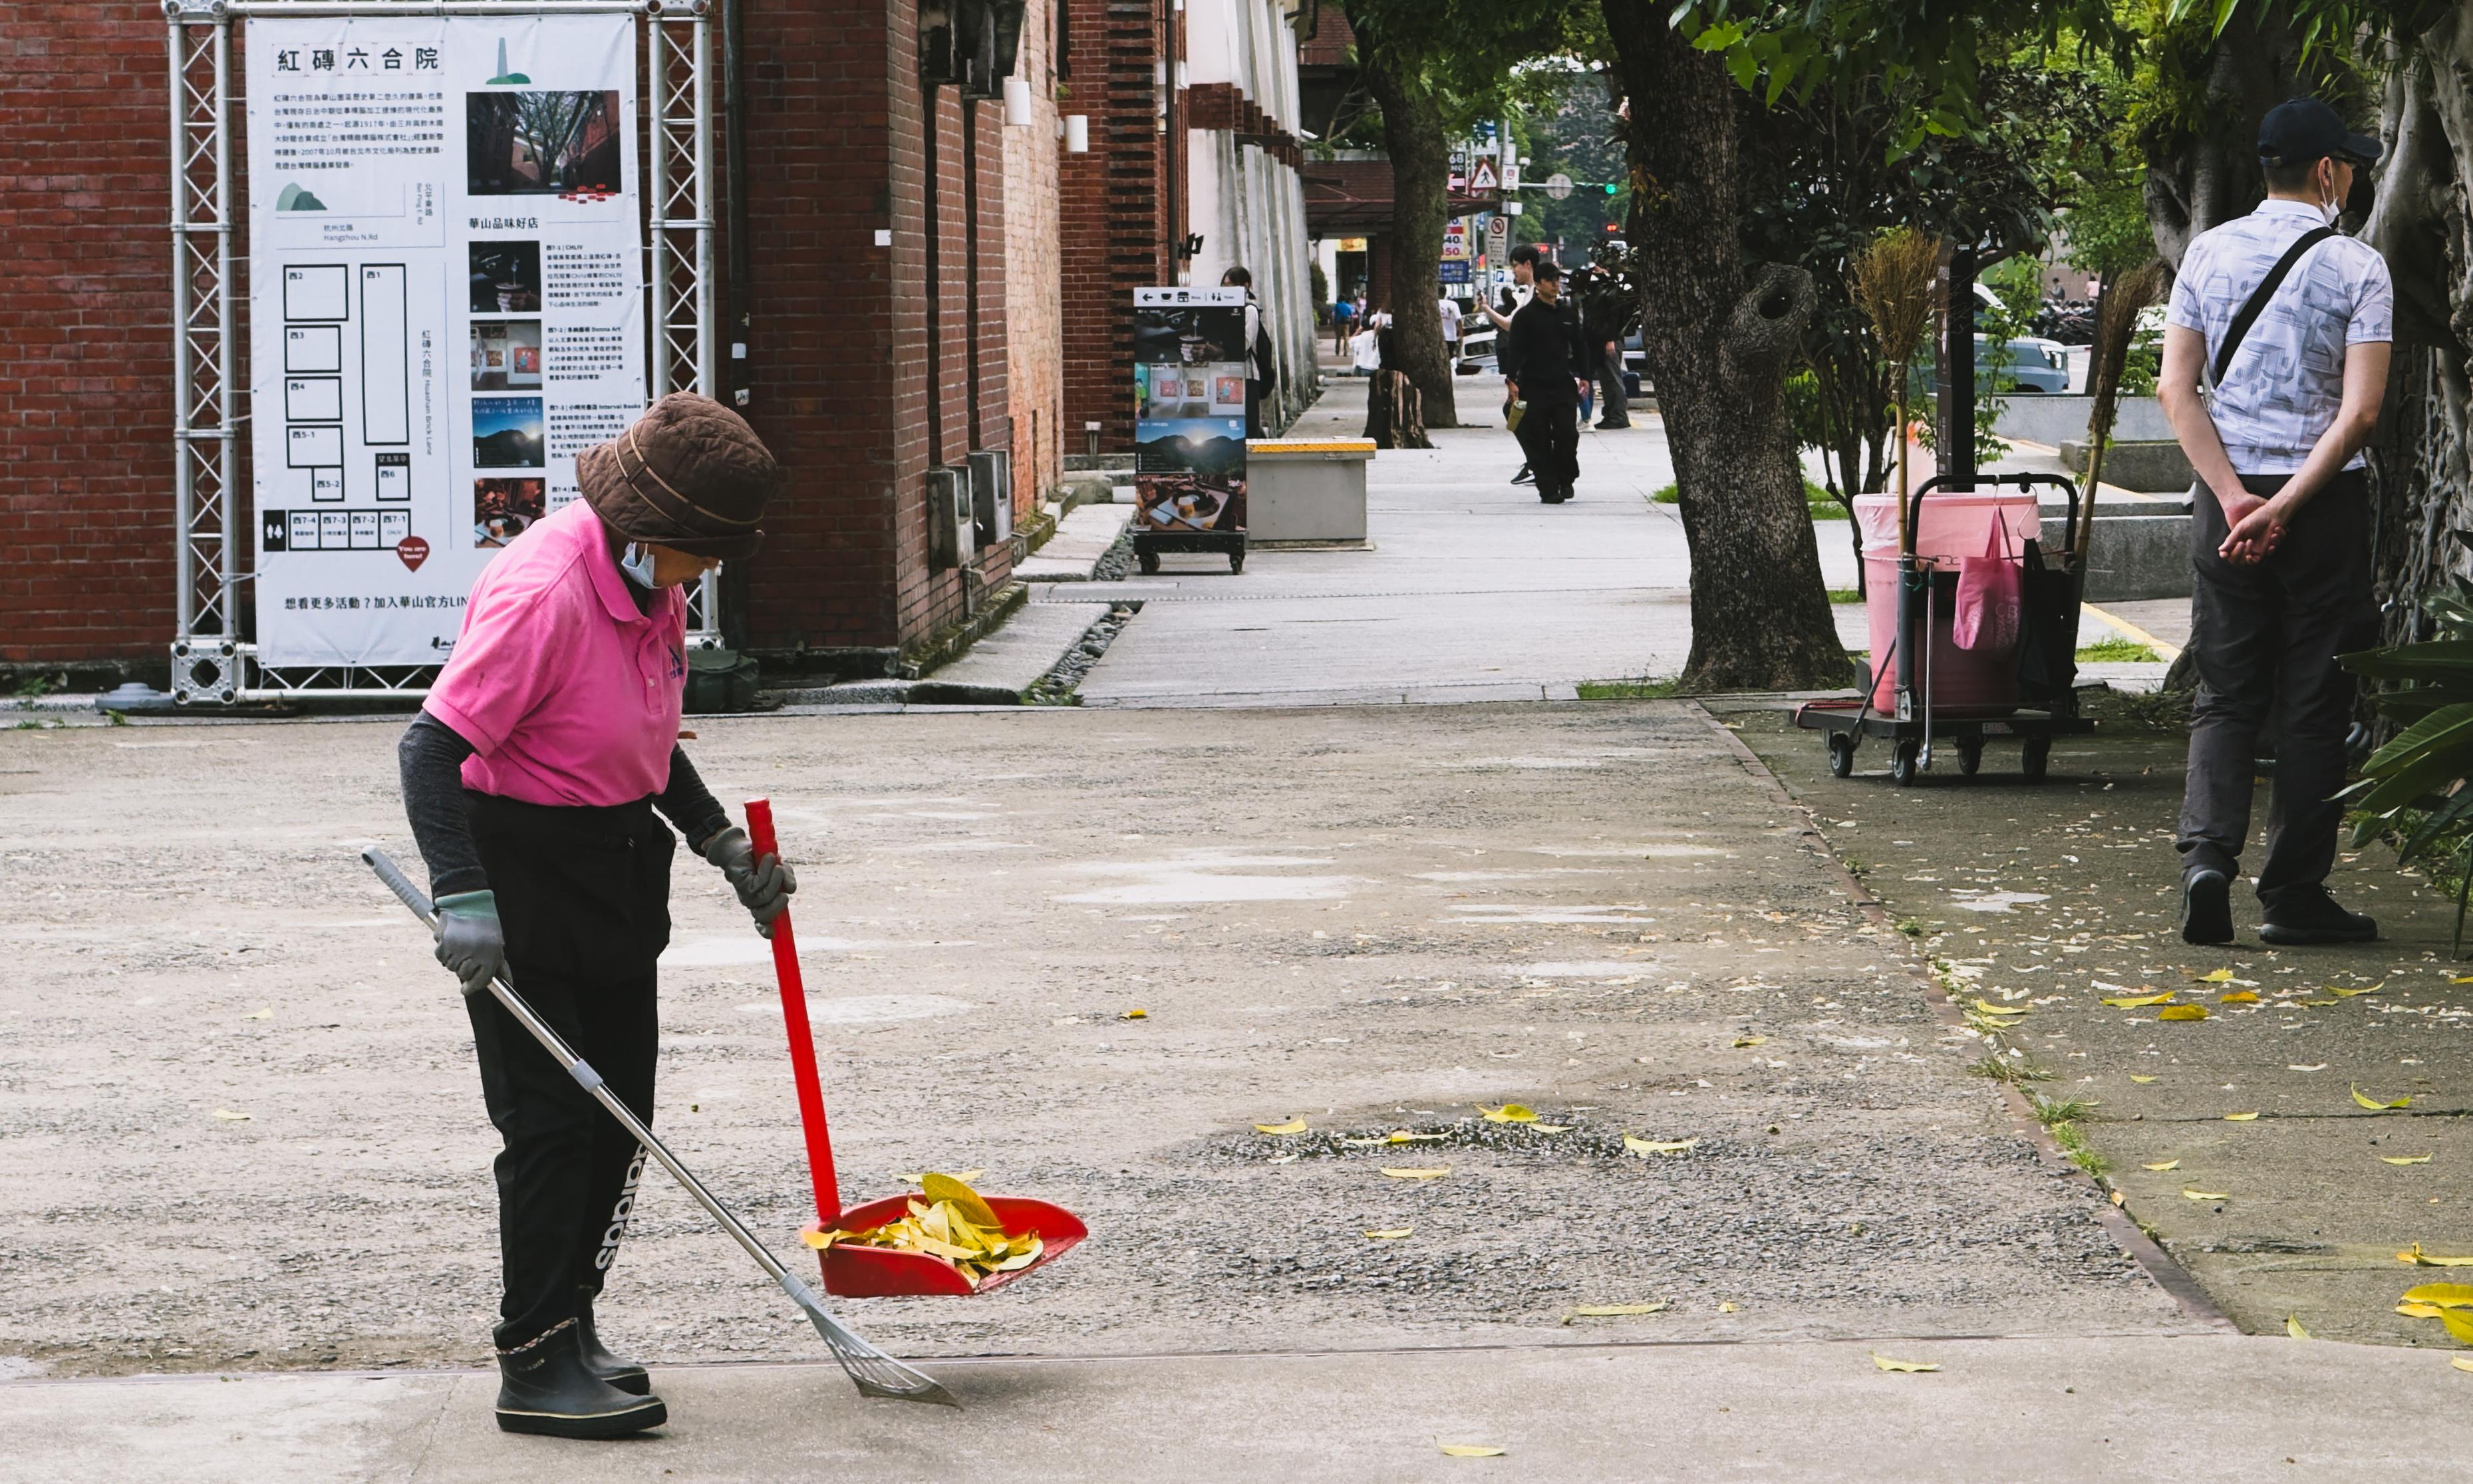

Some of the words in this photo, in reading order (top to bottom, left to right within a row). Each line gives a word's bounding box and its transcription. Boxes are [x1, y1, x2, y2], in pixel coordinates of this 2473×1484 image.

[277, 47, 439, 72] 紅磚六合院
[468, 217, 539, 230] 華山品味好店
[323, 233, 360, 242] Hangzhou
